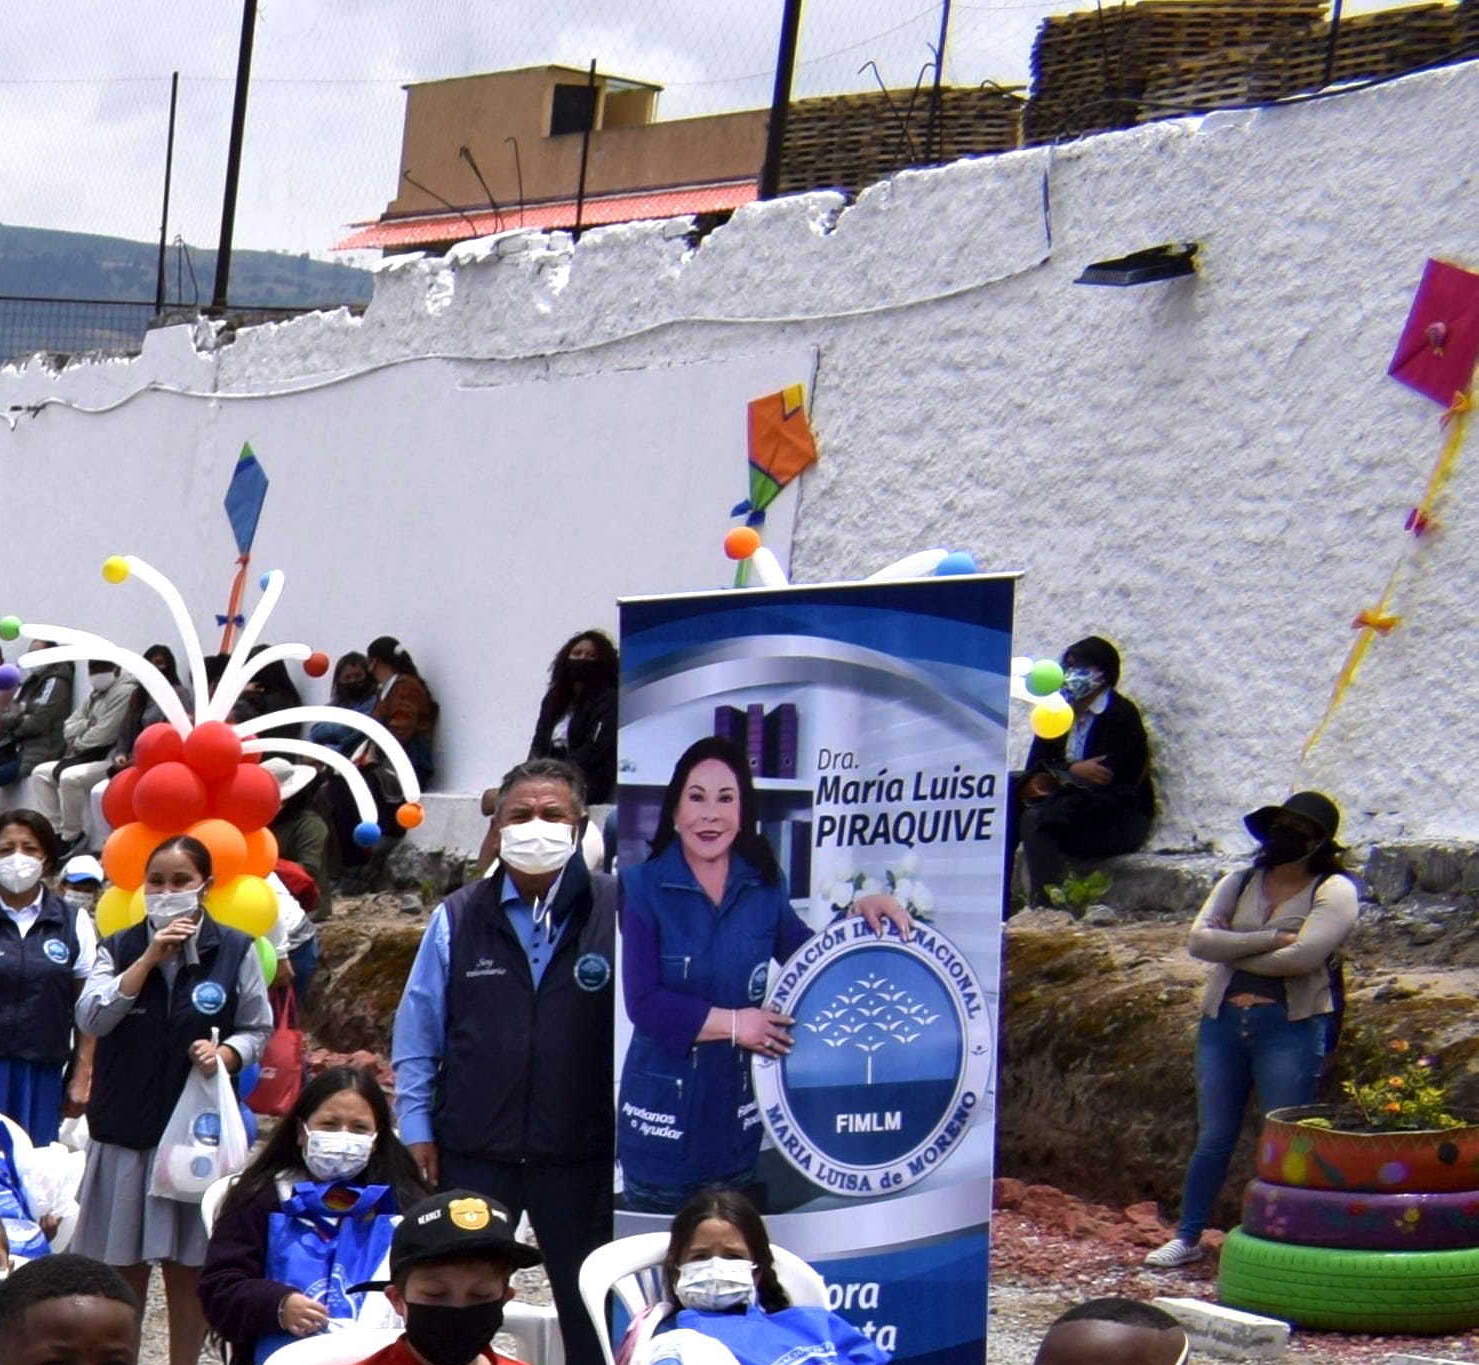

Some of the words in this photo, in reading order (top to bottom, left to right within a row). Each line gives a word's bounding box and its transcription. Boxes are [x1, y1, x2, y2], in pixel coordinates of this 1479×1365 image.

[817, 748, 860, 771] Dra.
[816, 768, 905, 806] María
[912, 764, 997, 802] Luisa
[815, 808, 996, 850] PIRAQUIVE
[772, 929, 847, 1015] UNDACIÓN
[766, 1103, 812, 1172] MARIA
[815, 1162, 872, 1193] LUISA
[879, 1169, 904, 1190] de
[907, 1091, 977, 1178] MORENO
[836, 1111, 903, 1134] FIMLM
[828, 1281, 880, 1310] ora
